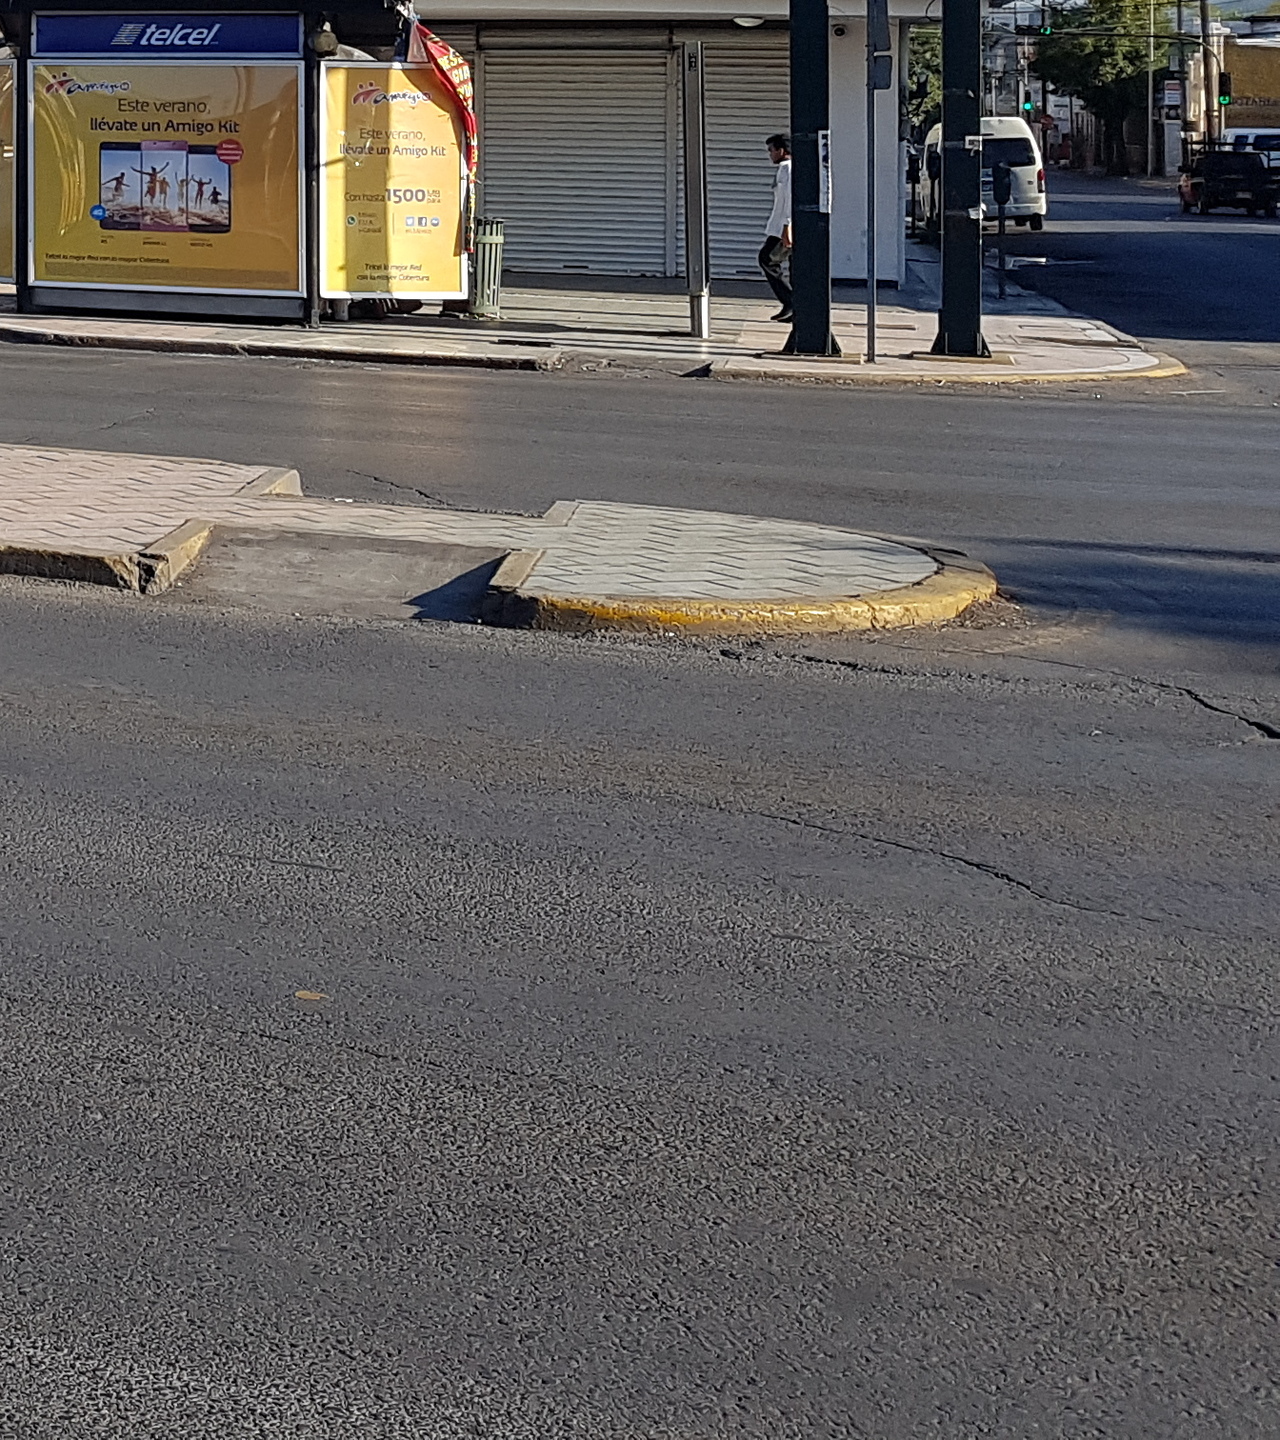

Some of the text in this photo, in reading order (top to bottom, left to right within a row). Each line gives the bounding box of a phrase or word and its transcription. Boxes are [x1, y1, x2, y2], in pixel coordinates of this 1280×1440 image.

[141, 23, 221, 46] telcel
[118, 99, 211, 115] Este verano,
[90, 118, 240, 135] llévate un Amigo Kit
[360, 128, 426, 141] Este verano,
[377, 147, 390, 155] un
[393, 145, 428, 158] Amigo
[431, 146, 446, 156] Kit
[385, 188, 426, 204] 1500
